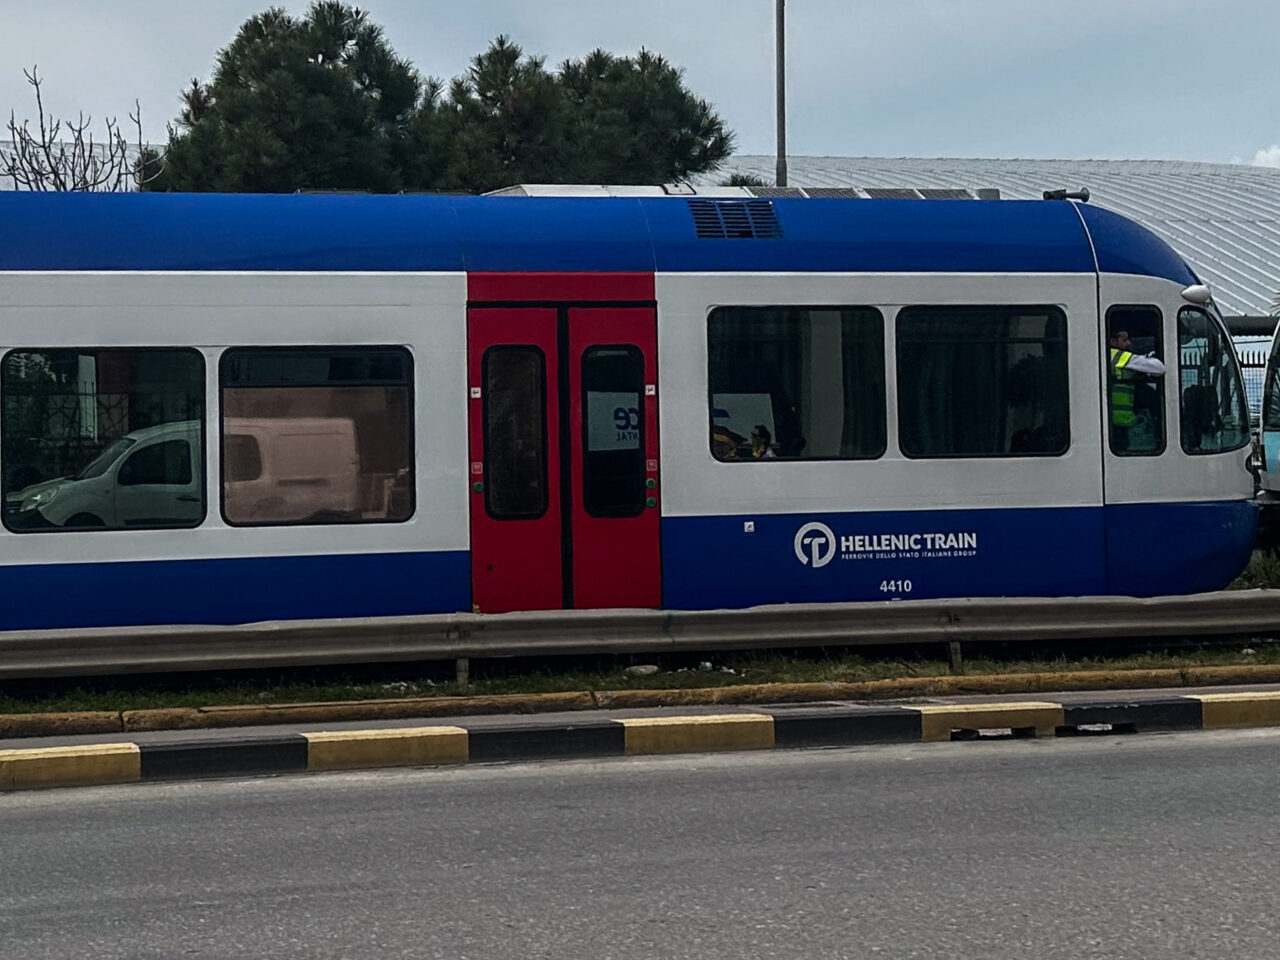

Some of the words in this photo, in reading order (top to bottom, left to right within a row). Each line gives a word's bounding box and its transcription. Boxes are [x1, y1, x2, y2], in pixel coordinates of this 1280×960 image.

[840, 533, 922, 552] HELLENIC
[923, 532, 977, 549] TRAIN
[879, 579, 913, 593] 4410
